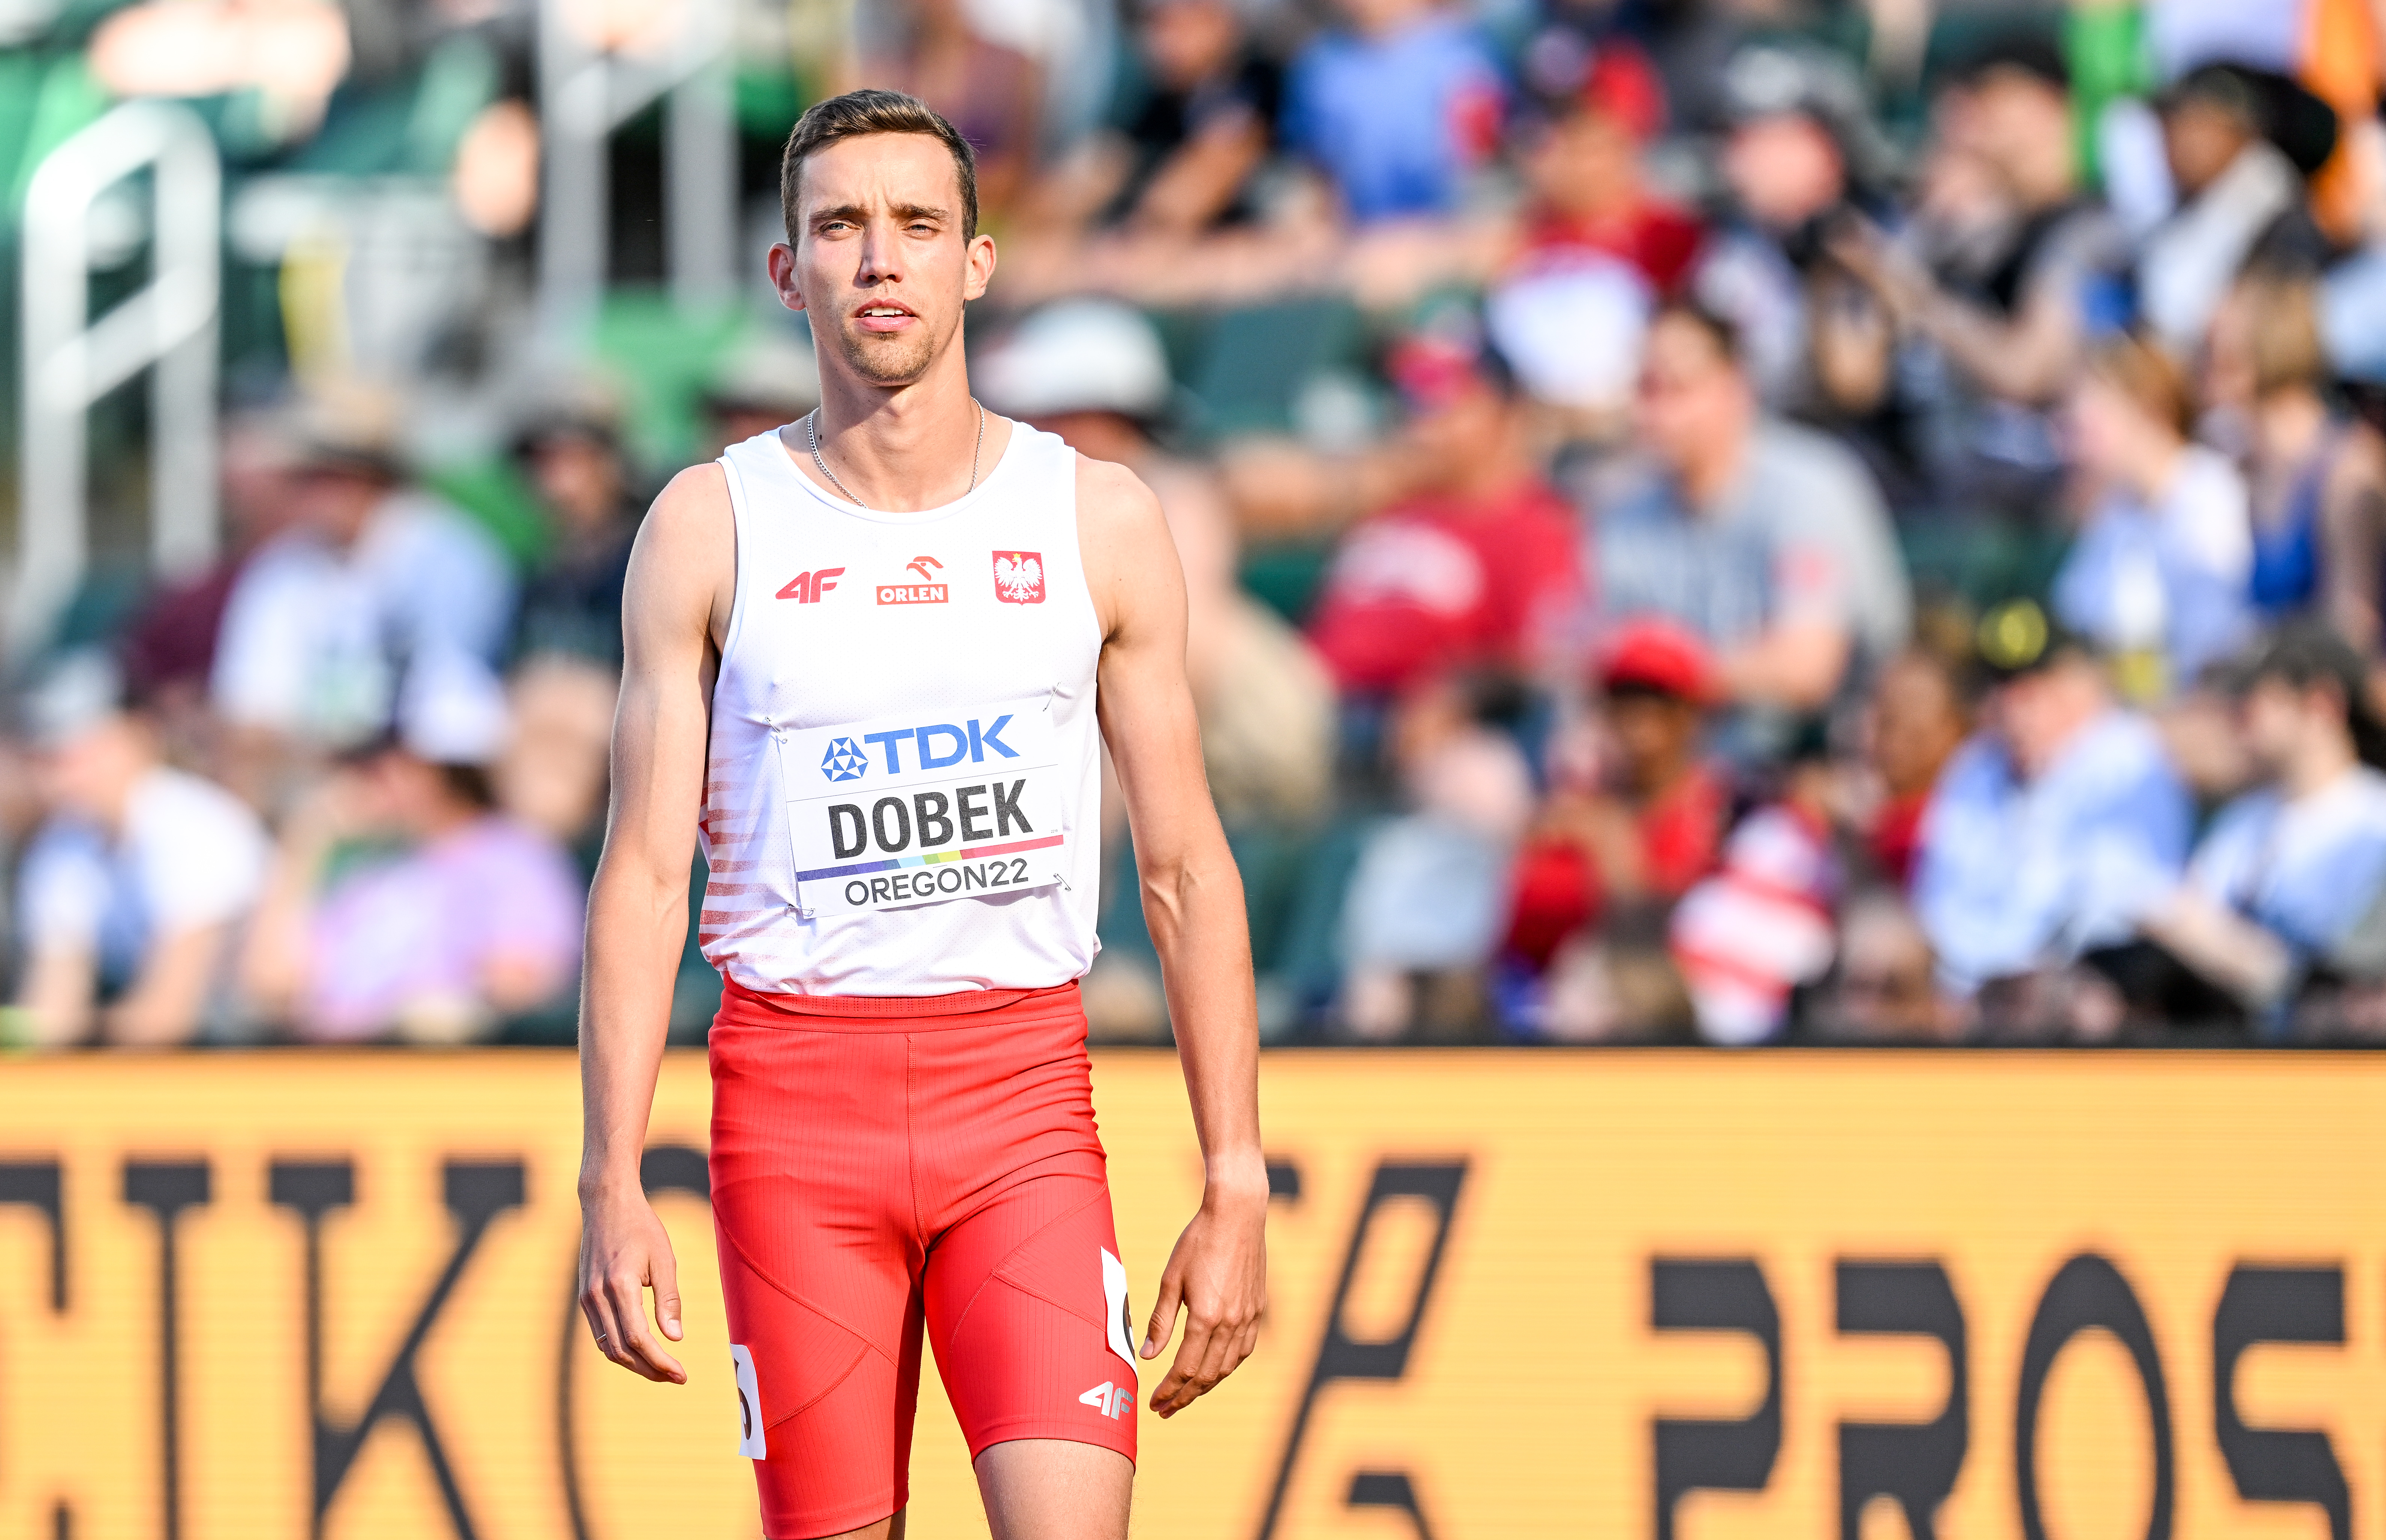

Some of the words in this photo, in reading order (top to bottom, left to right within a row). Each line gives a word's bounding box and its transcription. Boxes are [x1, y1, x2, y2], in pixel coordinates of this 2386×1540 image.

[775, 567, 846, 604] 4F
[880, 587, 944, 603] ORLEN
[864, 714, 1021, 774] TDK
[828, 779, 1034, 860] DOBEK
[845, 858, 1029, 906] OREGON22
[1079, 1381, 1134, 1420] 4F
